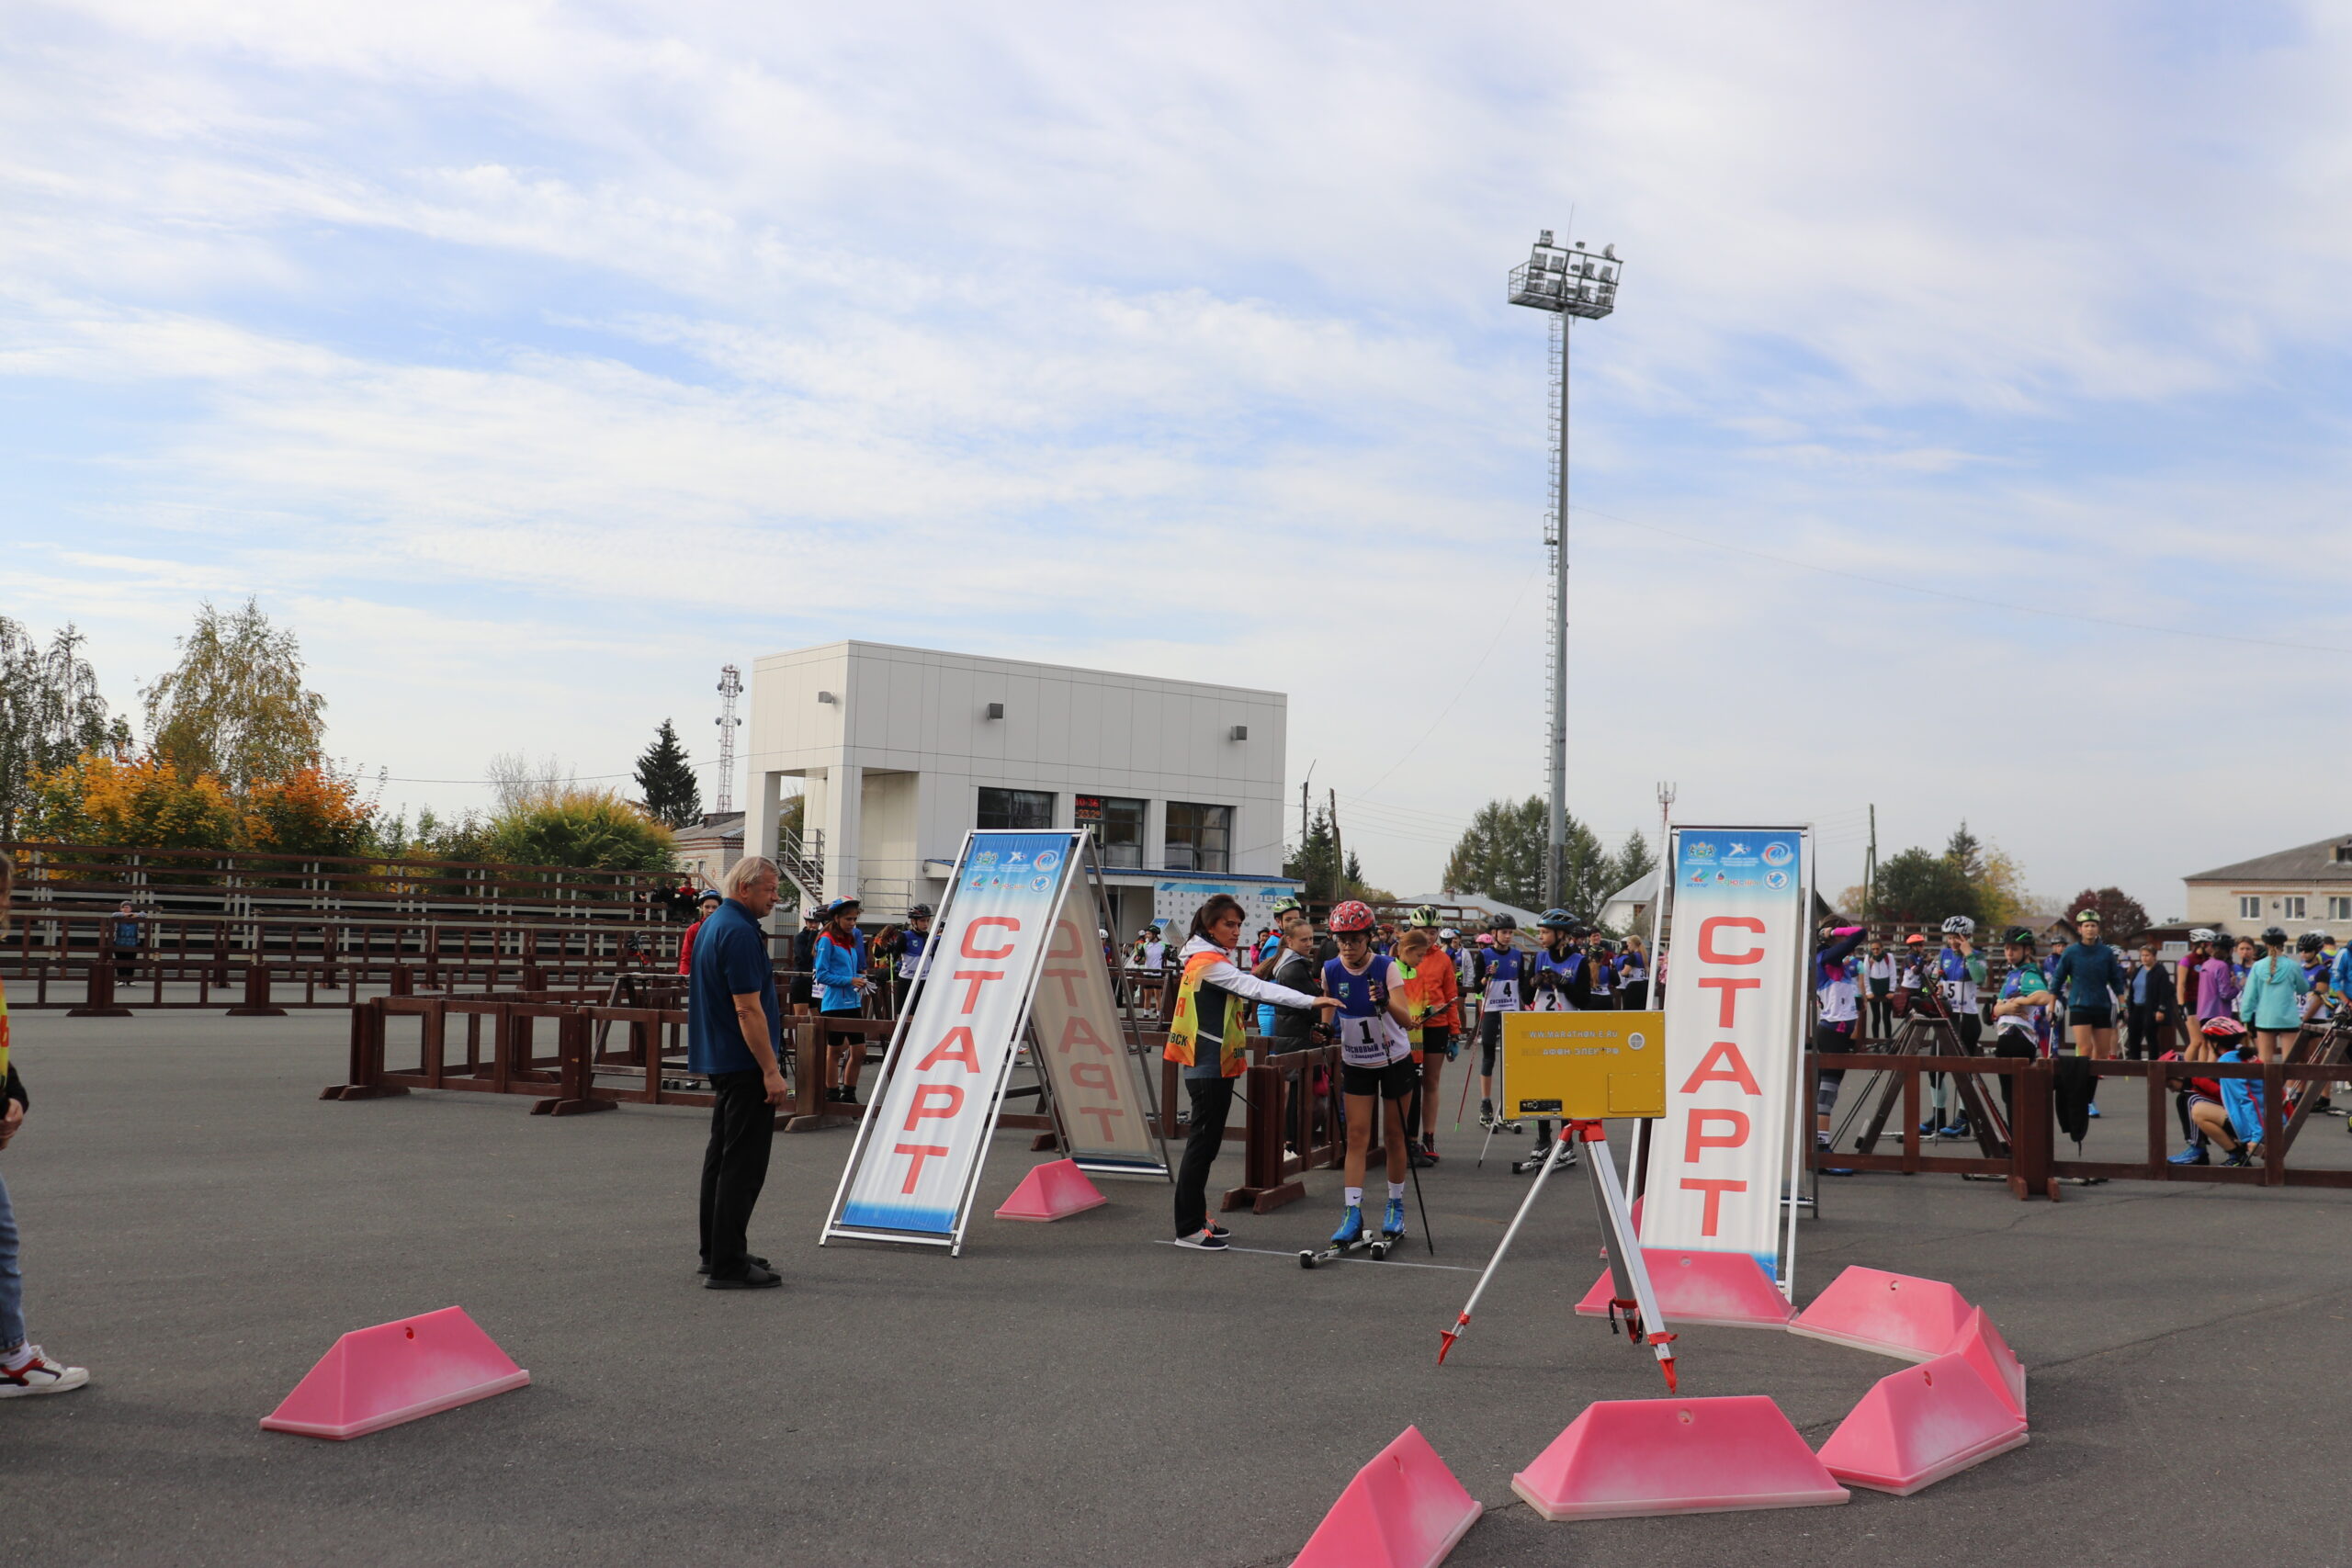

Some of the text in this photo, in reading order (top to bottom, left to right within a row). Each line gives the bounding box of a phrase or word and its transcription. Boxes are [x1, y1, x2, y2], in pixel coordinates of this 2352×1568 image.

[1503, 982, 1512, 998] 4
[1947, 983, 1955, 998] 5
[1545, 993, 1556, 1010] 2
[1359, 1021, 1374, 1043] 1
[893, 916, 1021, 1195] СТАРТ
[1679, 916, 1766, 1237] СТАРТ
